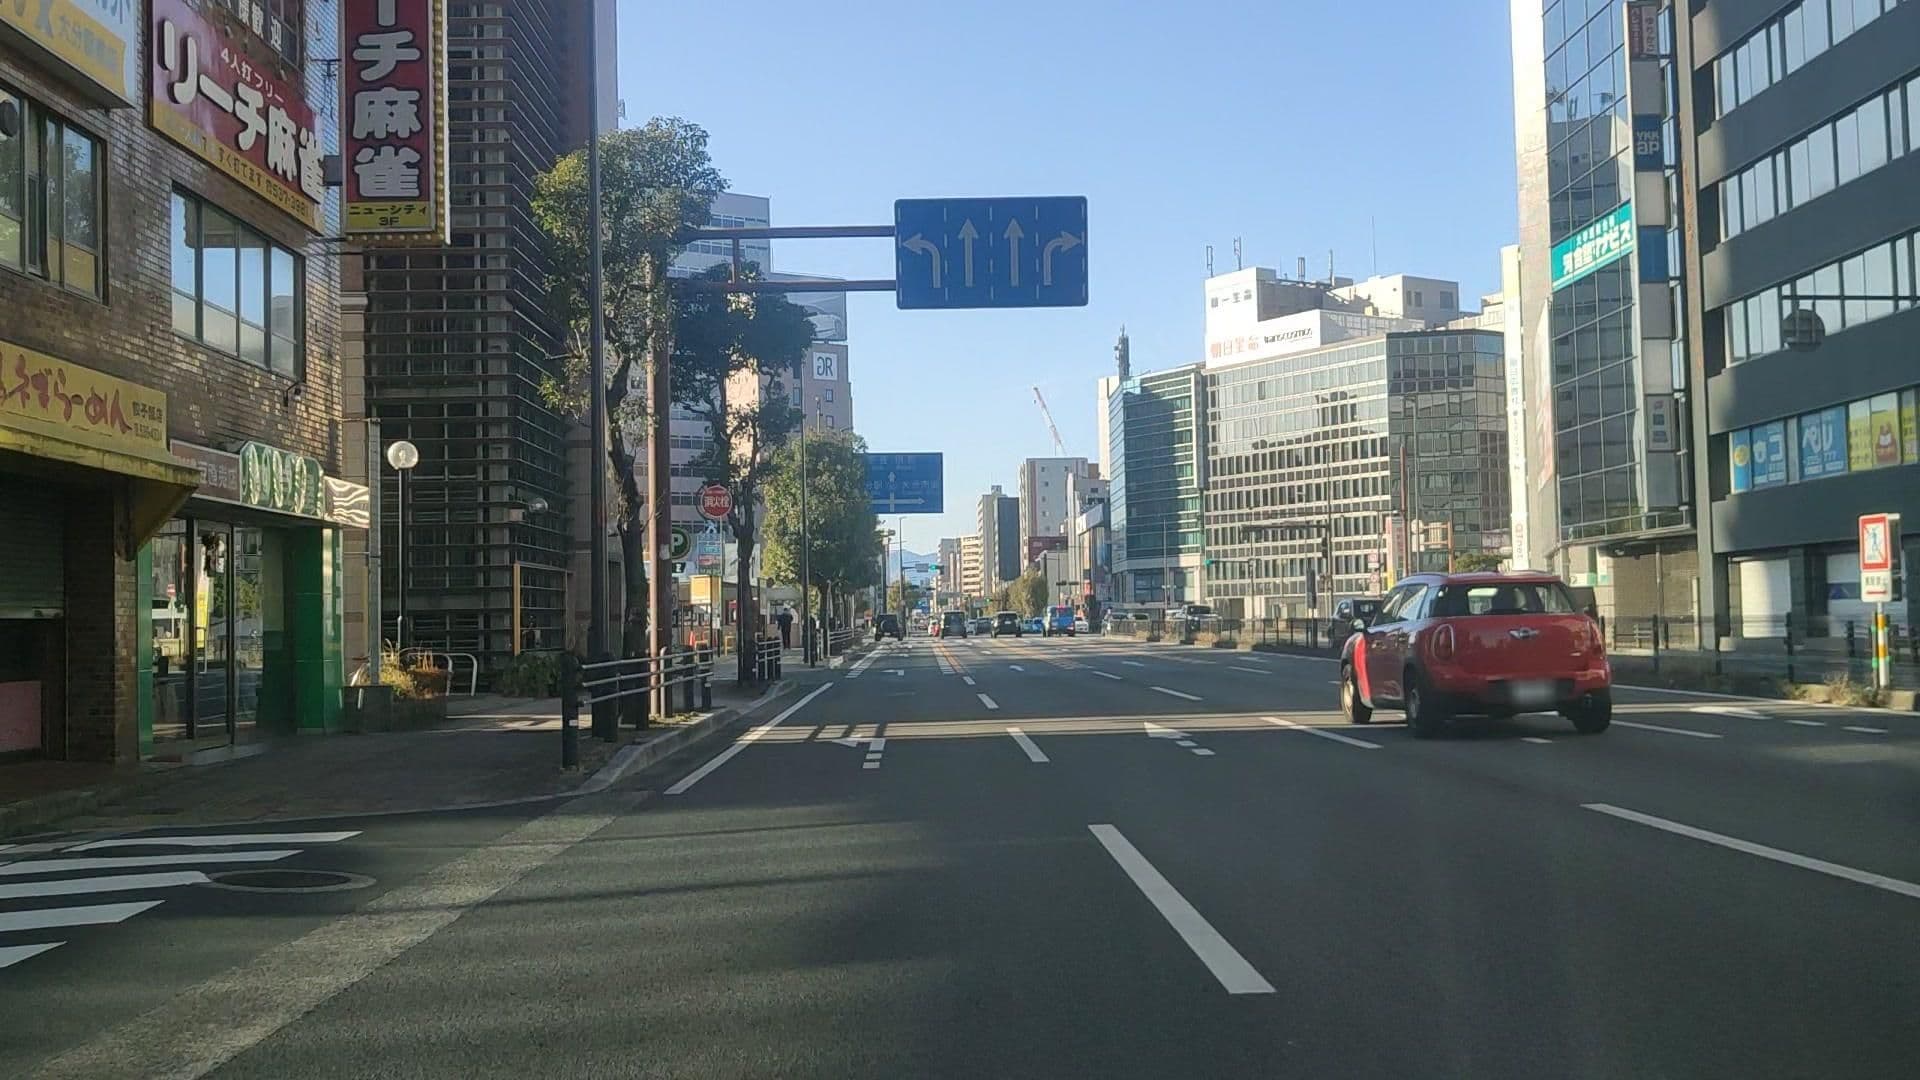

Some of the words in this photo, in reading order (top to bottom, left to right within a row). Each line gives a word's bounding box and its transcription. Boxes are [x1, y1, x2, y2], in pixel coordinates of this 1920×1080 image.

[220, 47, 285, 103] 4人打フリー
[161, 18, 325, 206] リーチ麻雀
[1637, 141, 1660, 156] ap
[348, 203, 427, 216] ニューシティ
[378, 215, 400, 227] 3F
